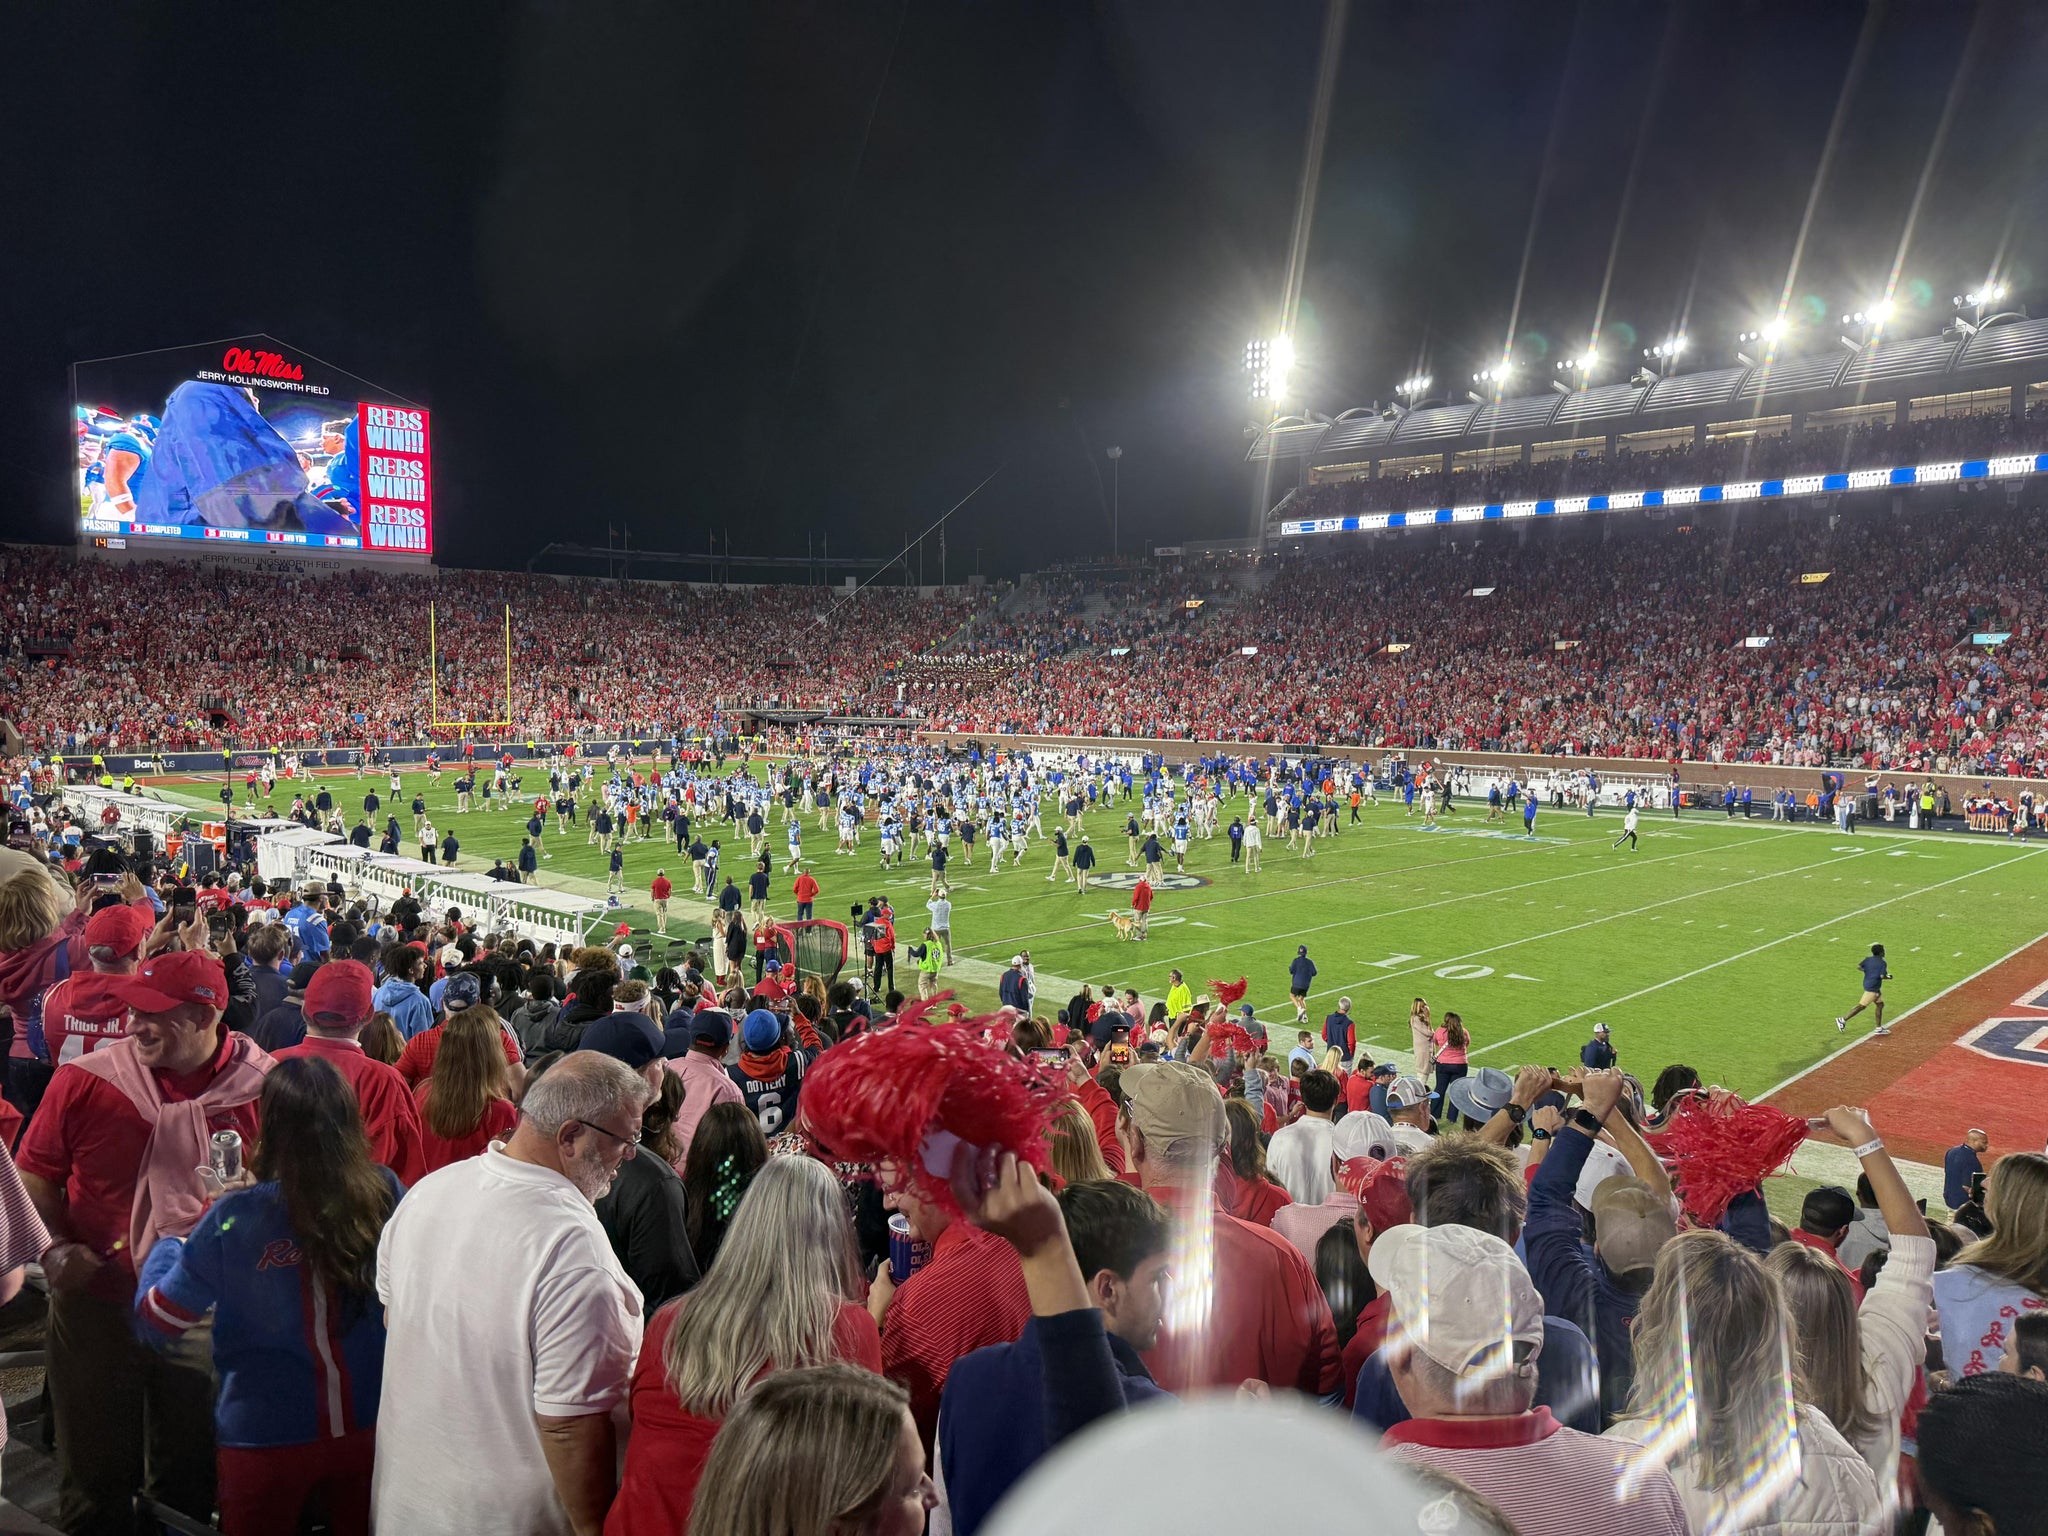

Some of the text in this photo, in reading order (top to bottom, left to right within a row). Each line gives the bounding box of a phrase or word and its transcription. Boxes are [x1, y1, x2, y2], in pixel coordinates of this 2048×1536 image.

[223, 347, 304, 381] Ole Miss
[196, 370, 330, 395] JERRY HOLLINGSWORTH FIELD
[367, 406, 423, 431] REBS
[366, 425, 424, 454] WIN!!!
[368, 455, 424, 479] REBS
[367, 475, 425, 502] WIN!!!
[83, 519, 120, 532] PASSING
[370, 504, 425, 527] REBS
[146, 525, 182, 535] COMPLETED
[219, 530, 249, 539] ATTEMPTS
[369, 523, 427, 549] WIN!!!
[95, 538, 107, 548] 14
[200, 554, 340, 569] JERRY HOLLINGSWORTH FIELD
[1356, 952, 1496, 980] 10
[64, 1014, 123, 1034] TRIGG JR.
[757, 1091, 783, 1134] 6
